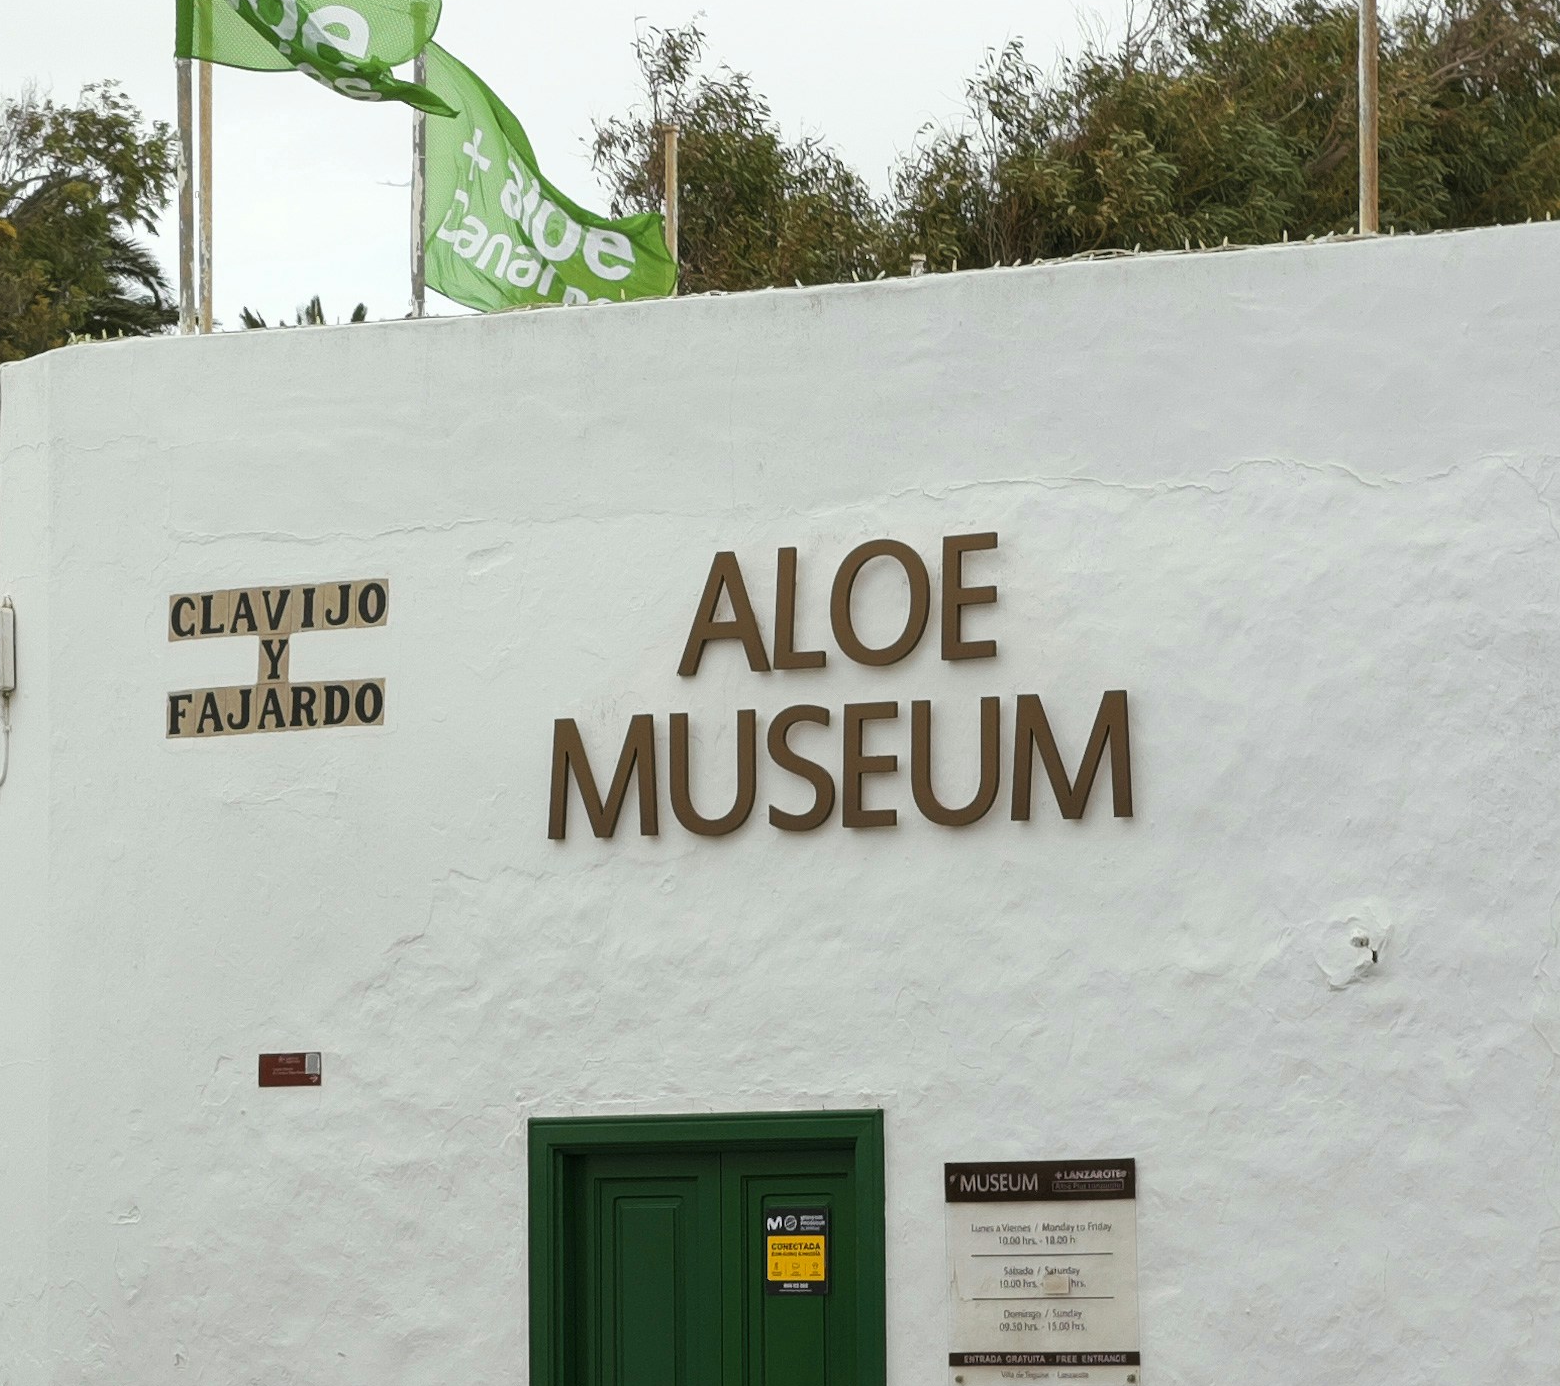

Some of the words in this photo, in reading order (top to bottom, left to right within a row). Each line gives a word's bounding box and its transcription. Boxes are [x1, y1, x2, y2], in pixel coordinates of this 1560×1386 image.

[500, 159, 636, 281] aloe
[171, 582, 386, 638] CLAVIJO
[677, 532, 998, 676] ALOE
[262, 639, 289, 680] Y
[169, 682, 384, 735] FAJARDO
[548, 689, 1133, 840] MUSEUM
[960, 1173, 1039, 1192] MUSEUM
[971, 1223, 995, 1233] Lunes
[1001, 1223, 1031, 1233] Viernes
[1042, 1222, 1074, 1233] Monday
[1076, 1224, 1085, 1232] to
[1087, 1221, 1112, 1232] Friday
[998, 1236, 1021, 1245] 10.00
[1044, 1265, 1080, 1275] Saturday
[1000, 1279, 1021, 1288] 10.00
[1004, 1309, 1041, 1320] Domingo
[1052, 1309, 1082, 1319] Sunday
[964, 1355, 1002, 1364] ENTRADA
[1005, 1354, 1046, 1364] GRATUITA
[1055, 1354, 1078, 1363] FREE
